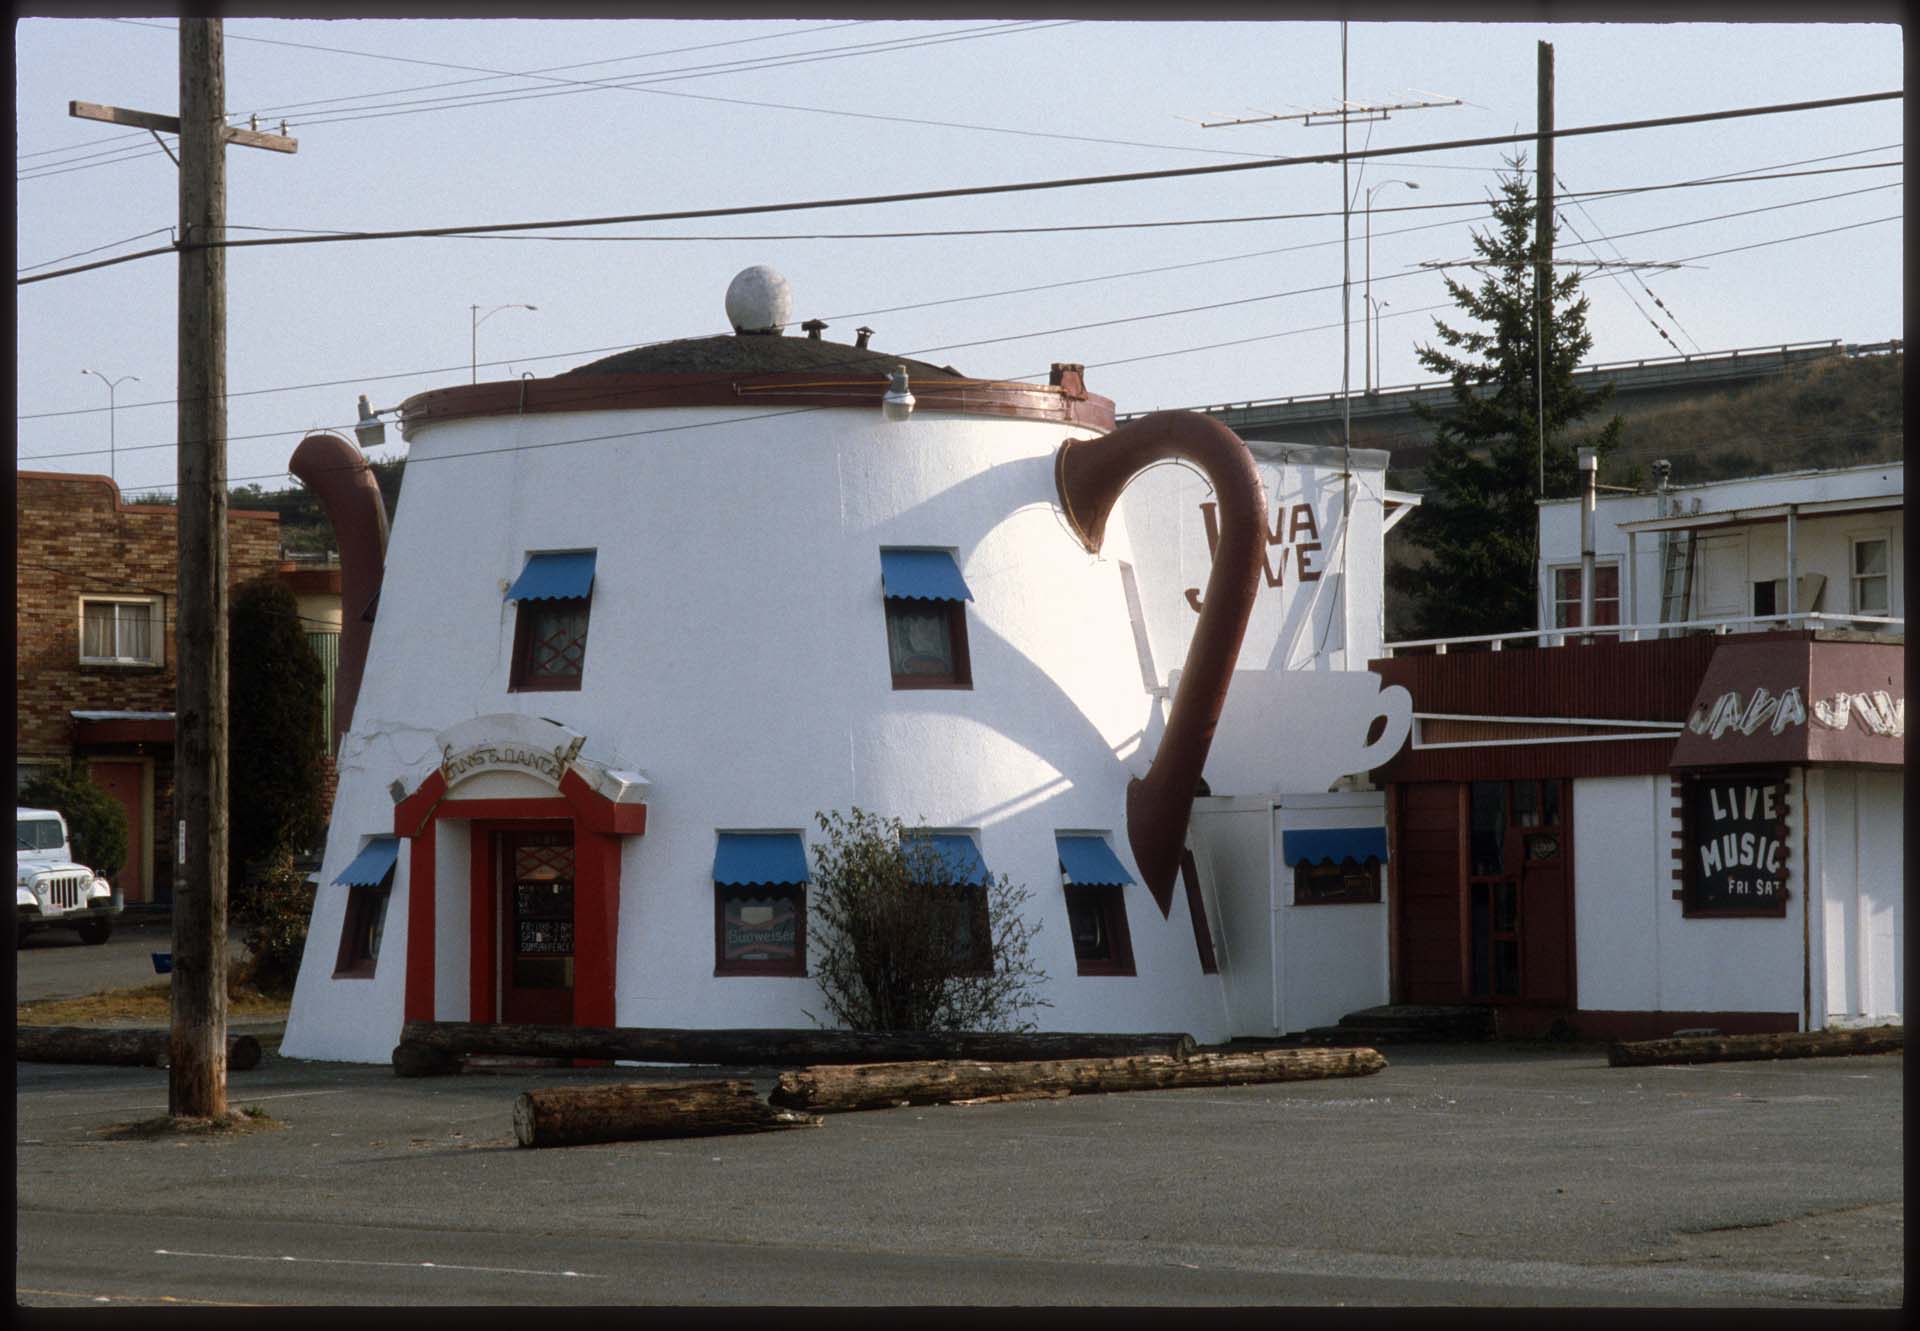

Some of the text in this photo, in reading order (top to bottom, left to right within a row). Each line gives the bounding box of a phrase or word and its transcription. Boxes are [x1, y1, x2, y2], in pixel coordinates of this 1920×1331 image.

[1689, 687, 1806, 740] JAVA
[1710, 785, 1777, 820] LIVE
[1700, 832, 1780, 878] MUSIC
[1728, 879, 1749, 895] FRI
